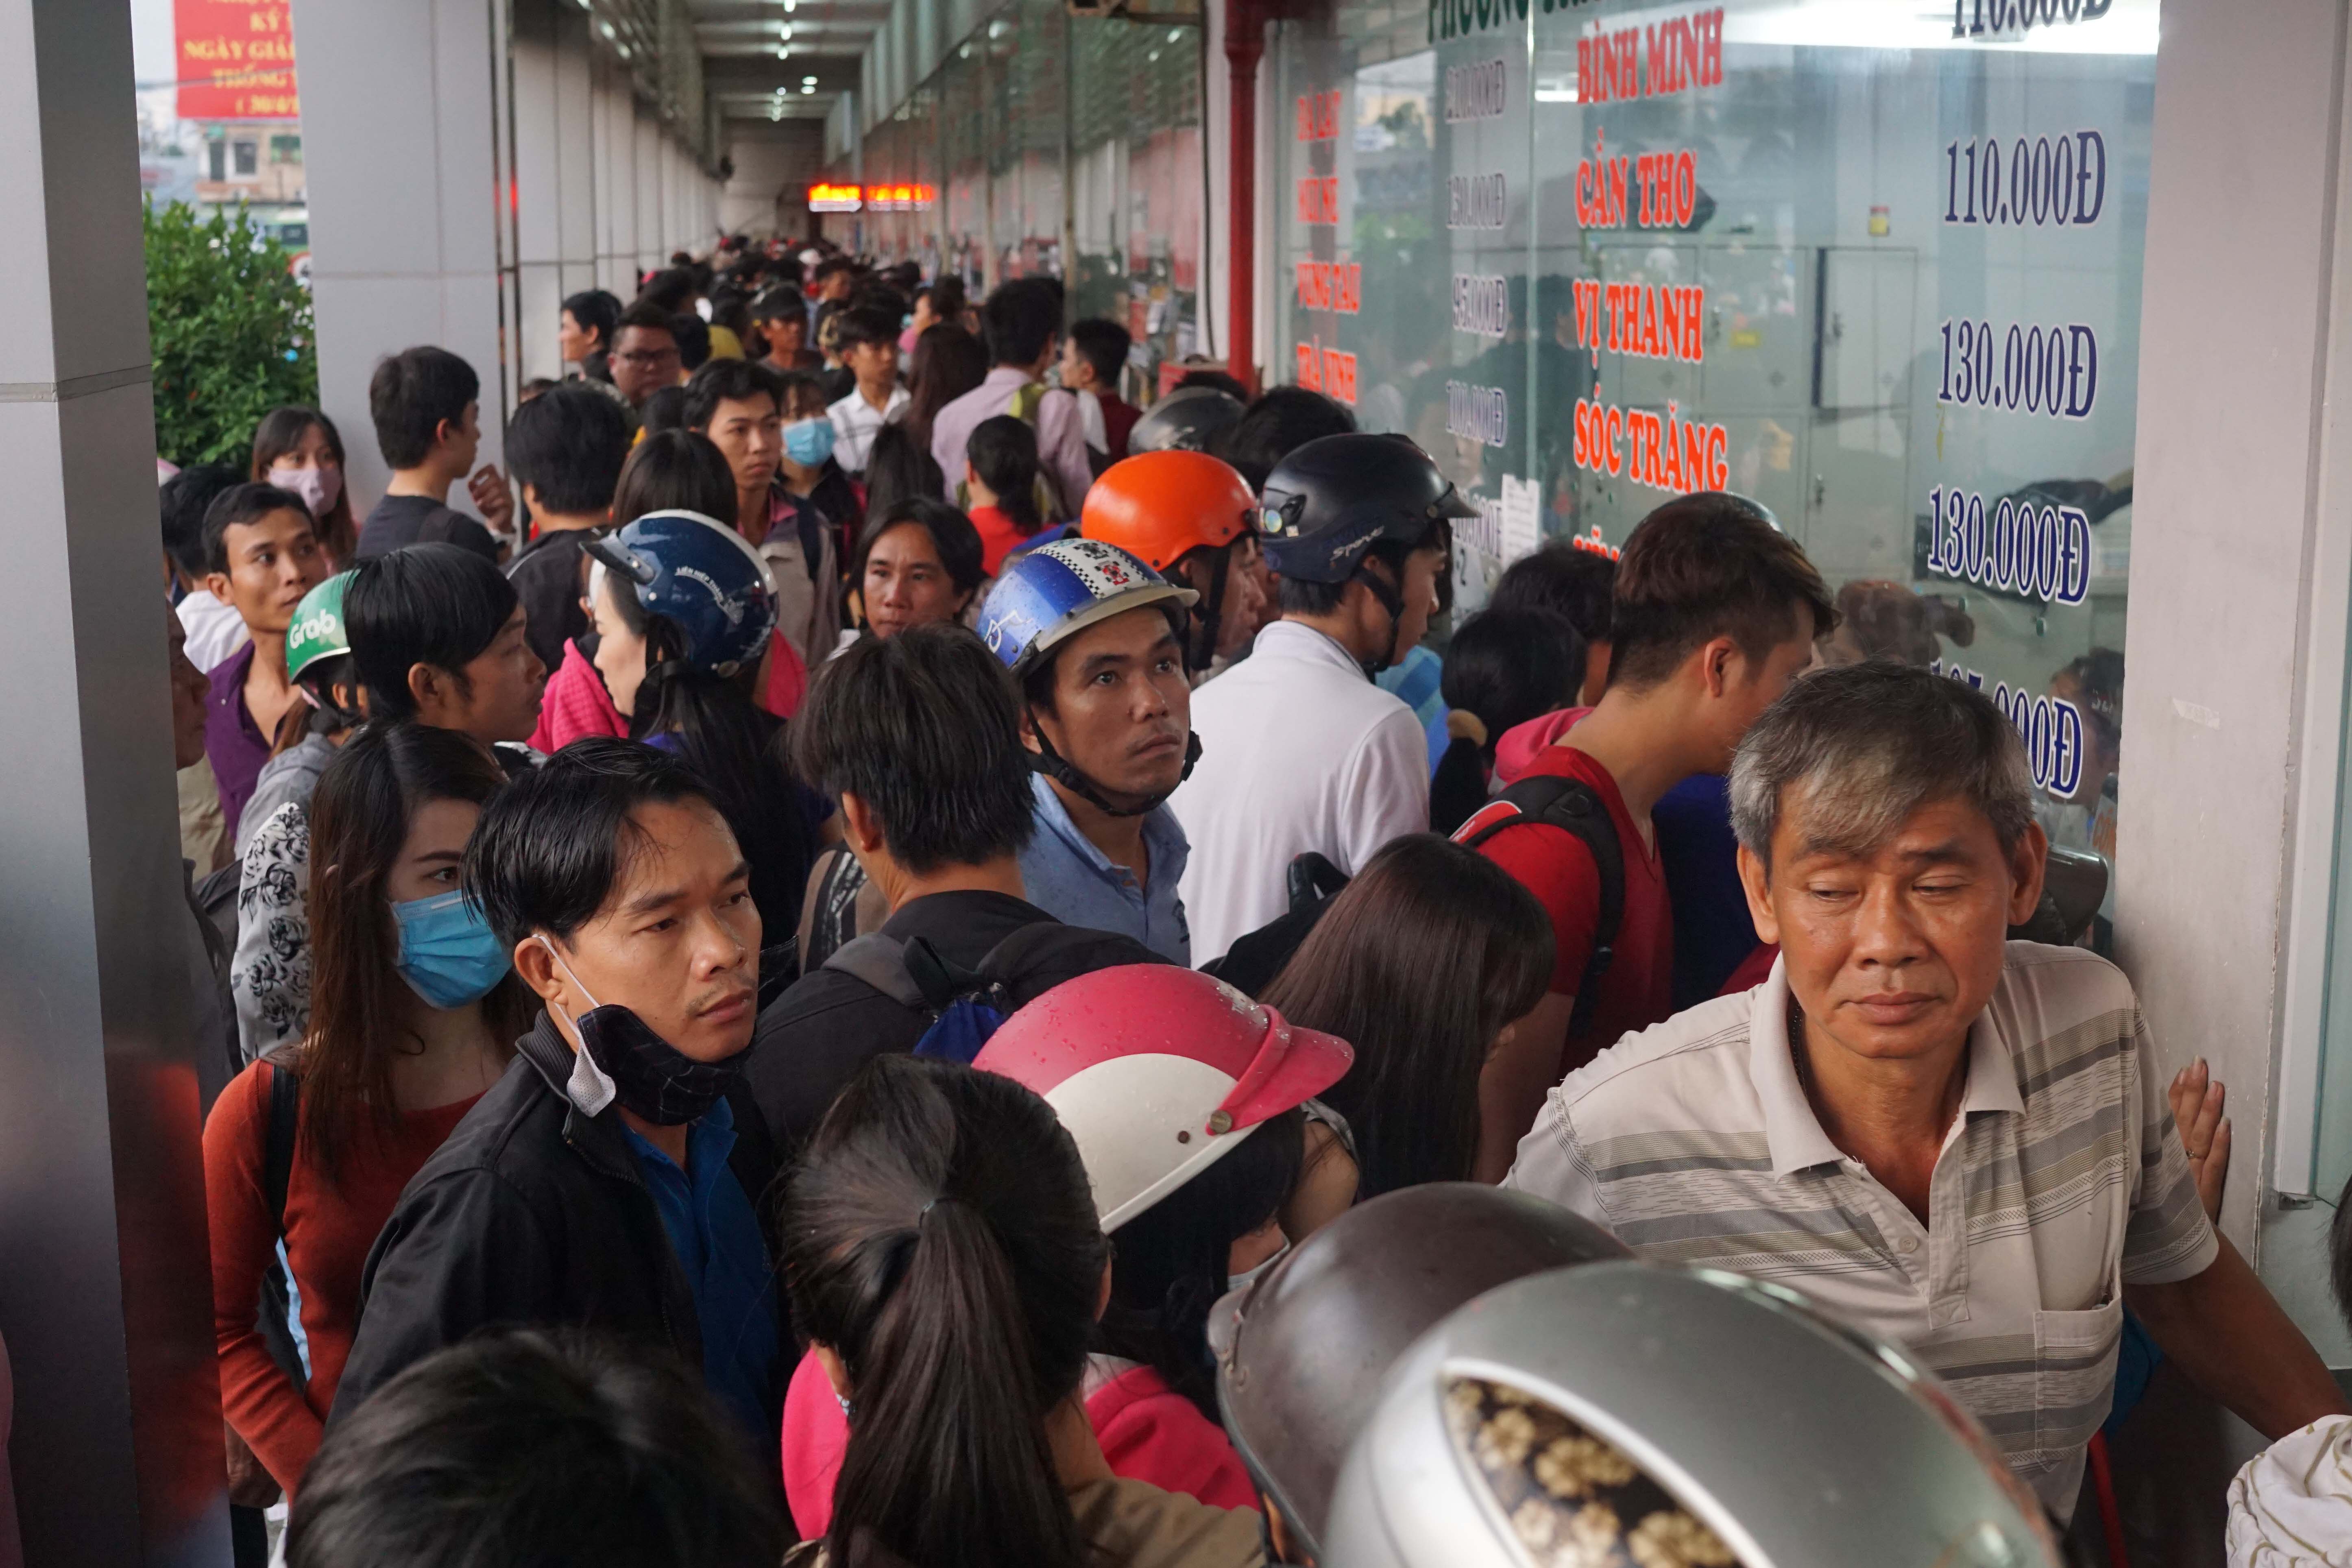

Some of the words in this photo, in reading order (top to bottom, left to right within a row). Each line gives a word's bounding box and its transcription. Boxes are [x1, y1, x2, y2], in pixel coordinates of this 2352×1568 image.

[1577, 19, 1638, 104] BÌNH
[1645, 7, 1722, 98] MINH
[1576, 128, 1628, 228] CẦN
[1637, 149, 1696, 228] THƠ
[1945, 131, 2106, 225] 110.000Đ
[1572, 280, 1599, 368] VỊ
[1606, 284, 1703, 362] THANH
[1939, 320, 2097, 417] 130.000Đ
[1573, 382, 1622, 475] SÓC
[1627, 399, 1729, 495] TRĂNG
[1929, 485, 2090, 605] 130.000Đ
[290, 608, 336, 649] Grab
